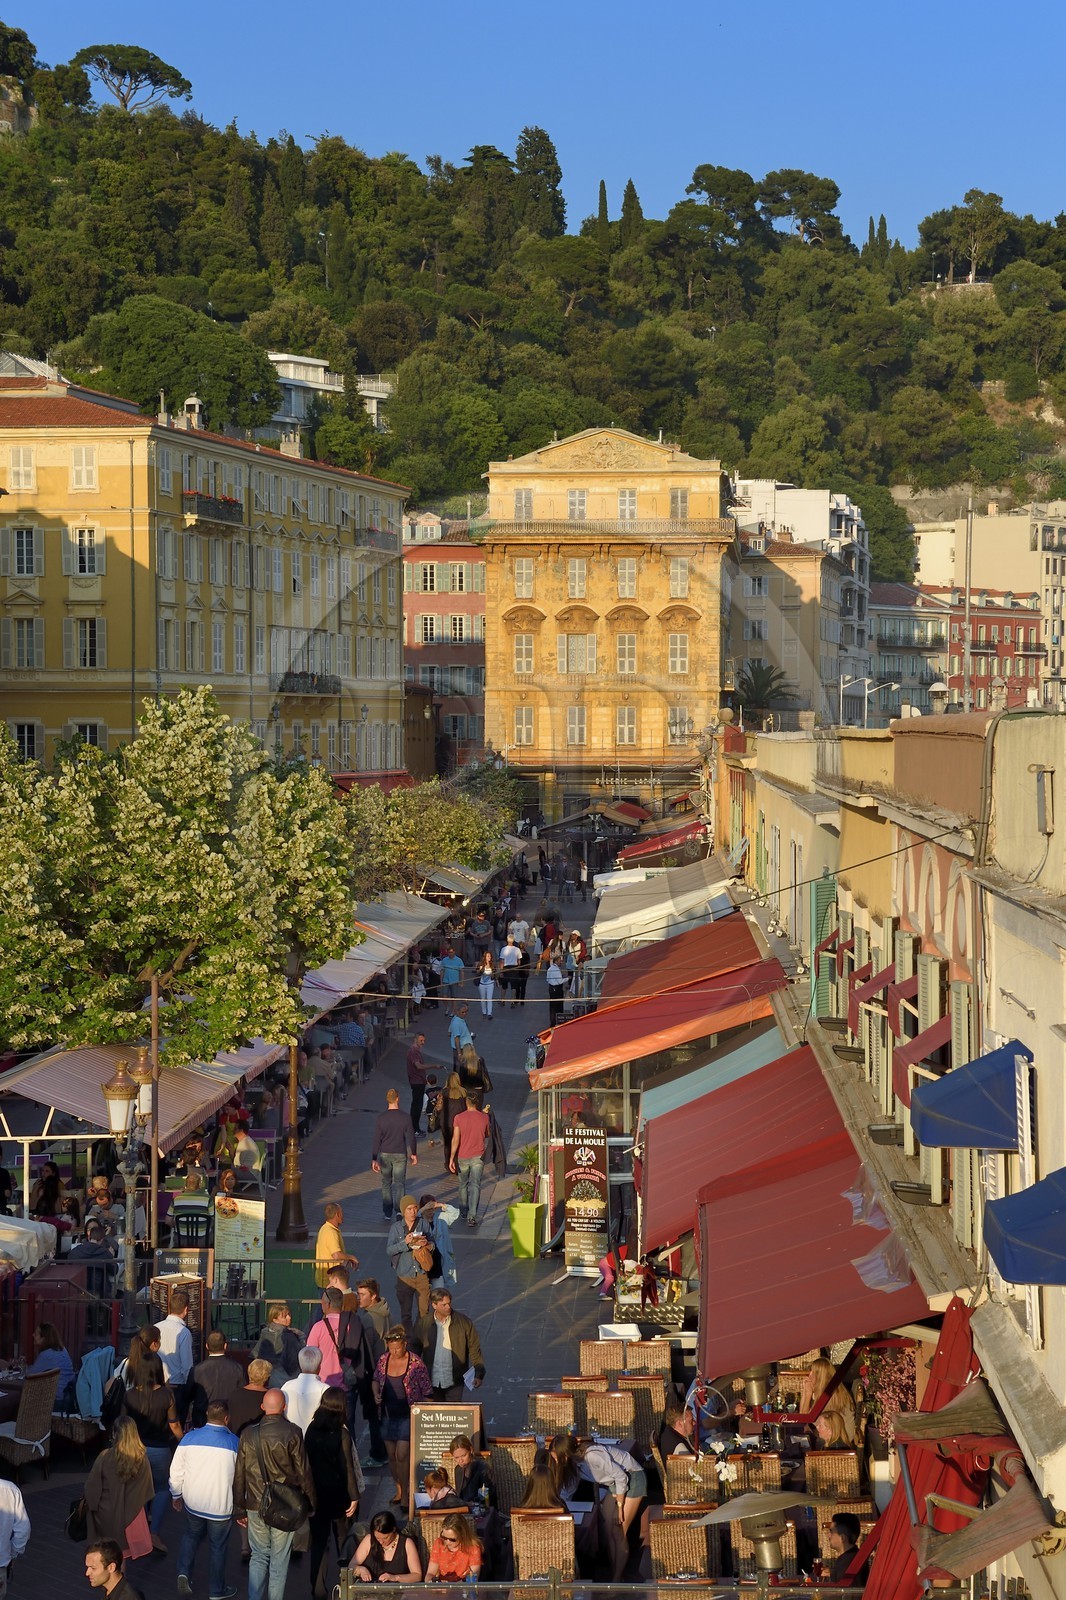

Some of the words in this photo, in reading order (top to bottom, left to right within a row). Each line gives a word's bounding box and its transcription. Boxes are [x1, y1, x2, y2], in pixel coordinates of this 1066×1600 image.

[575, 1128, 605, 1137] FESTIVAL
[421, 1412, 434, 1421] Set
[435, 1413, 456, 1421] Menu
